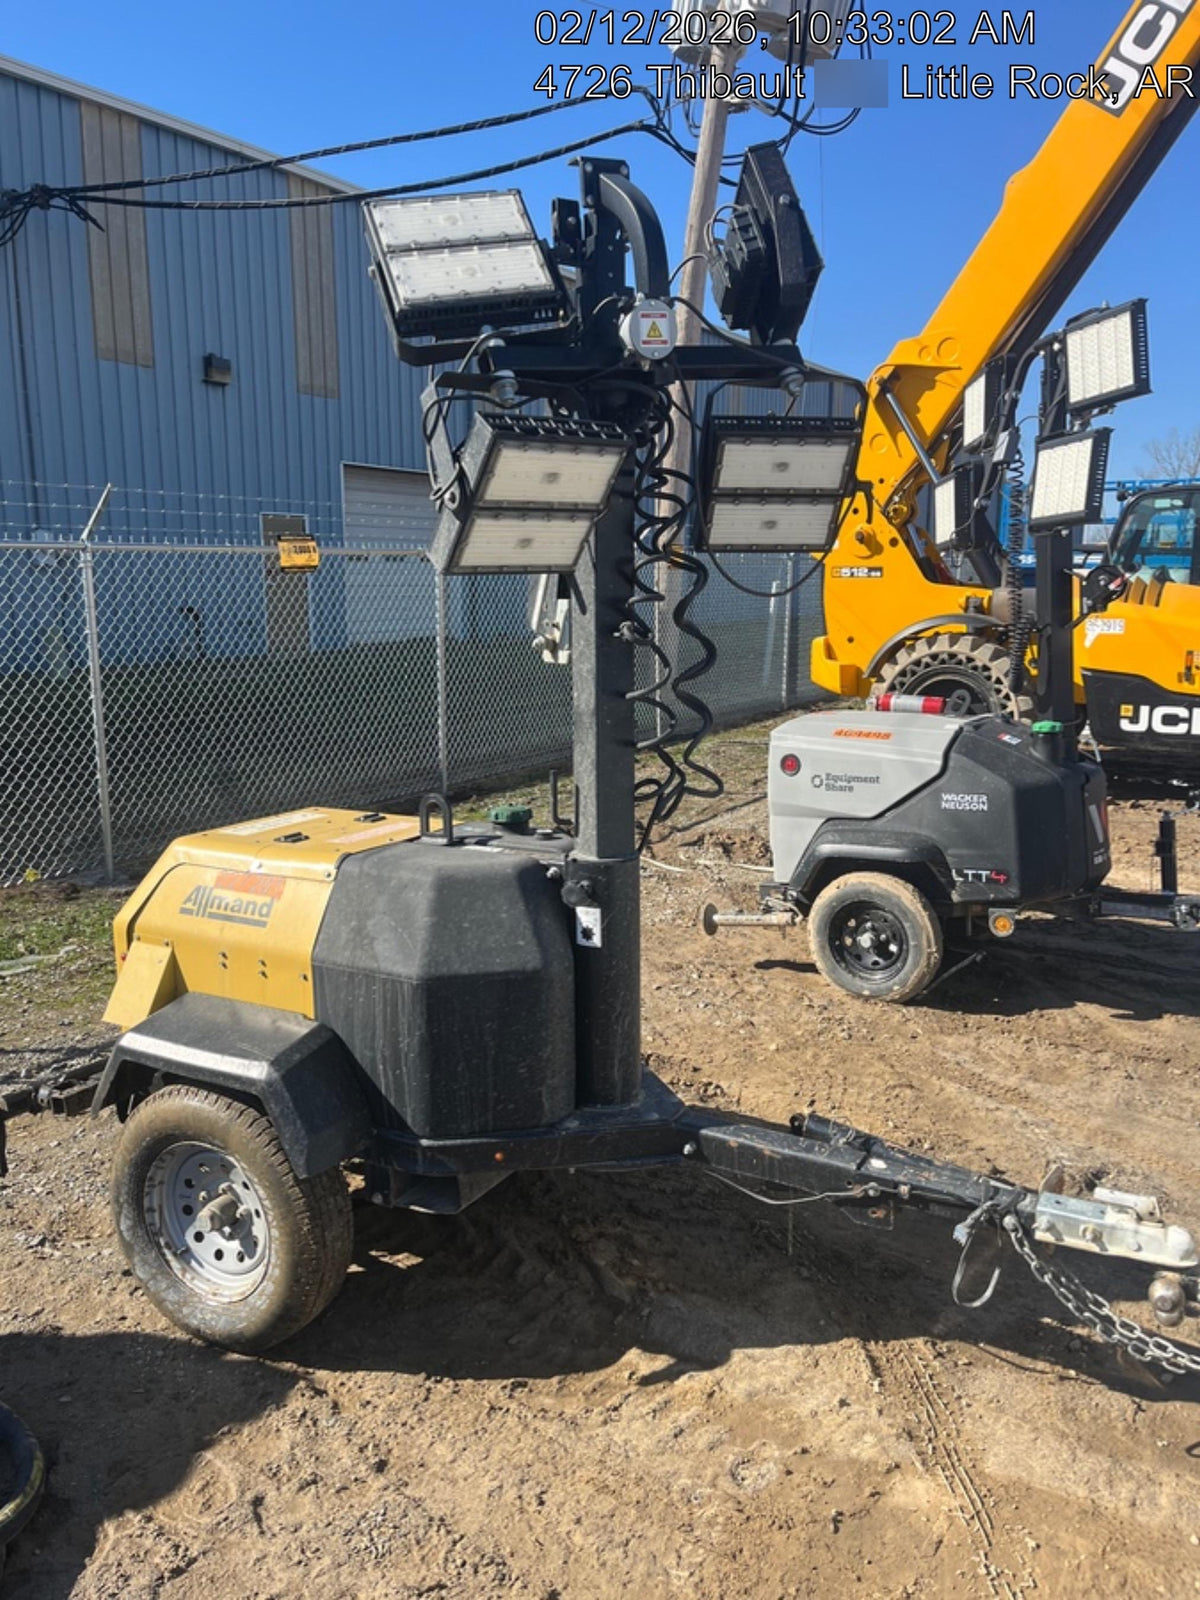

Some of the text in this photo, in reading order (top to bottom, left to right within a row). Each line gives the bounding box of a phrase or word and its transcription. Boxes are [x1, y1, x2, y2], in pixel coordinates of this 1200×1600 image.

[1096, 0, 1193, 109] JC
[825, 773, 880, 785] Equipment
[825, 783, 854, 793] Share
[941, 793, 988, 803] WACKER
[941, 801, 988, 811] NEUSON
[180, 884, 275, 919] Allmand
